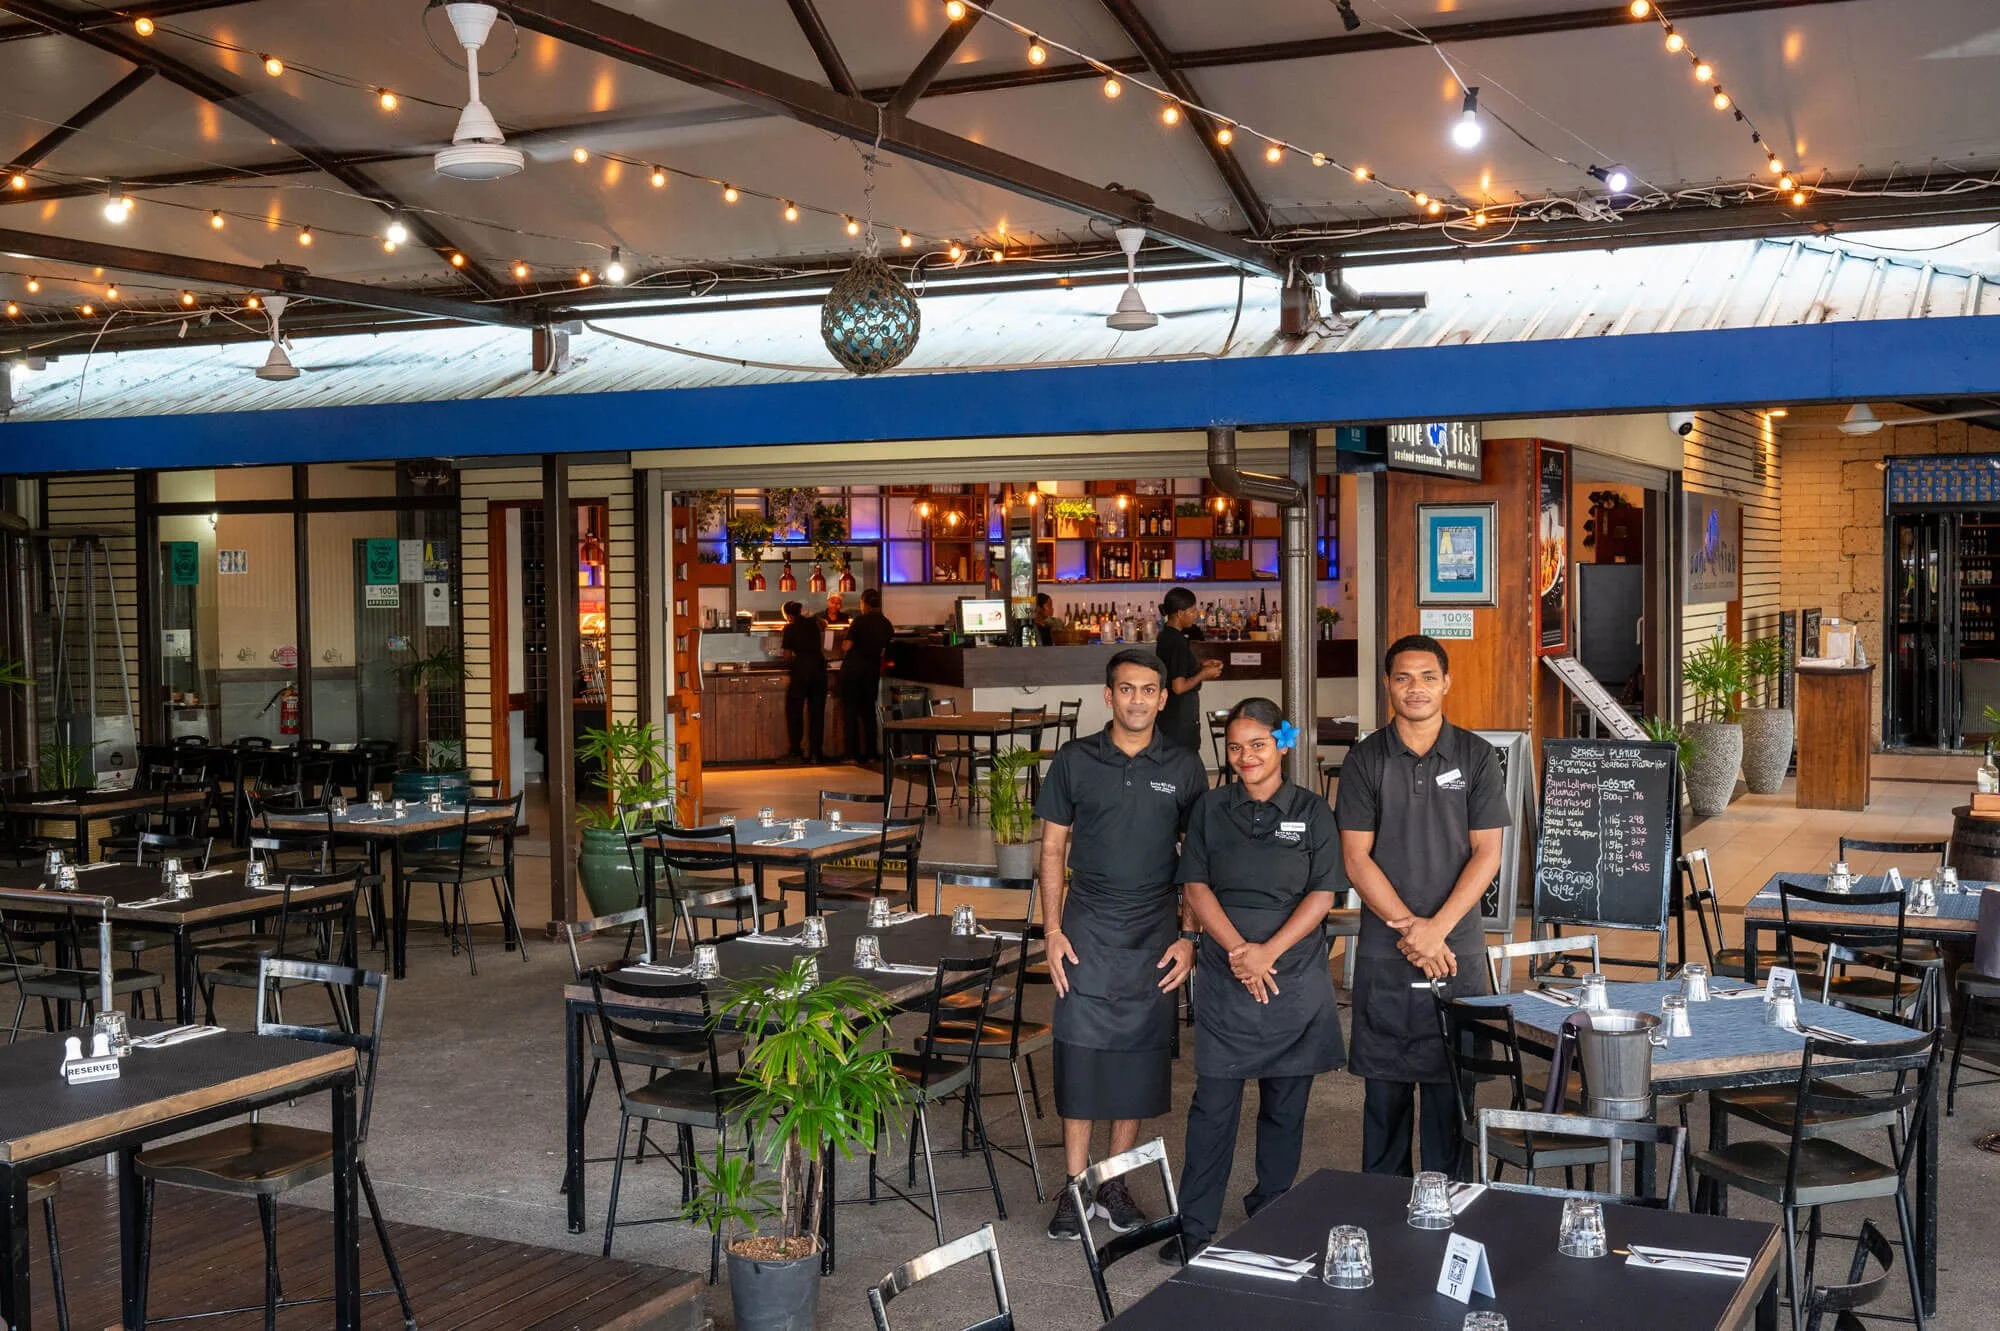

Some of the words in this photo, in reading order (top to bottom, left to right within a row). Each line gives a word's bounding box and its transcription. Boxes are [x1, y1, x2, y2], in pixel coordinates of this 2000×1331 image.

[1451, 422, 1478, 457] fish
[379, 587, 398, 596] 100%
[1442, 613, 1471, 623] 100%
[883, 860, 906, 870] STEP
[68, 1063, 118, 1076] RESERVED
[1449, 1282, 1458, 1296] 11
